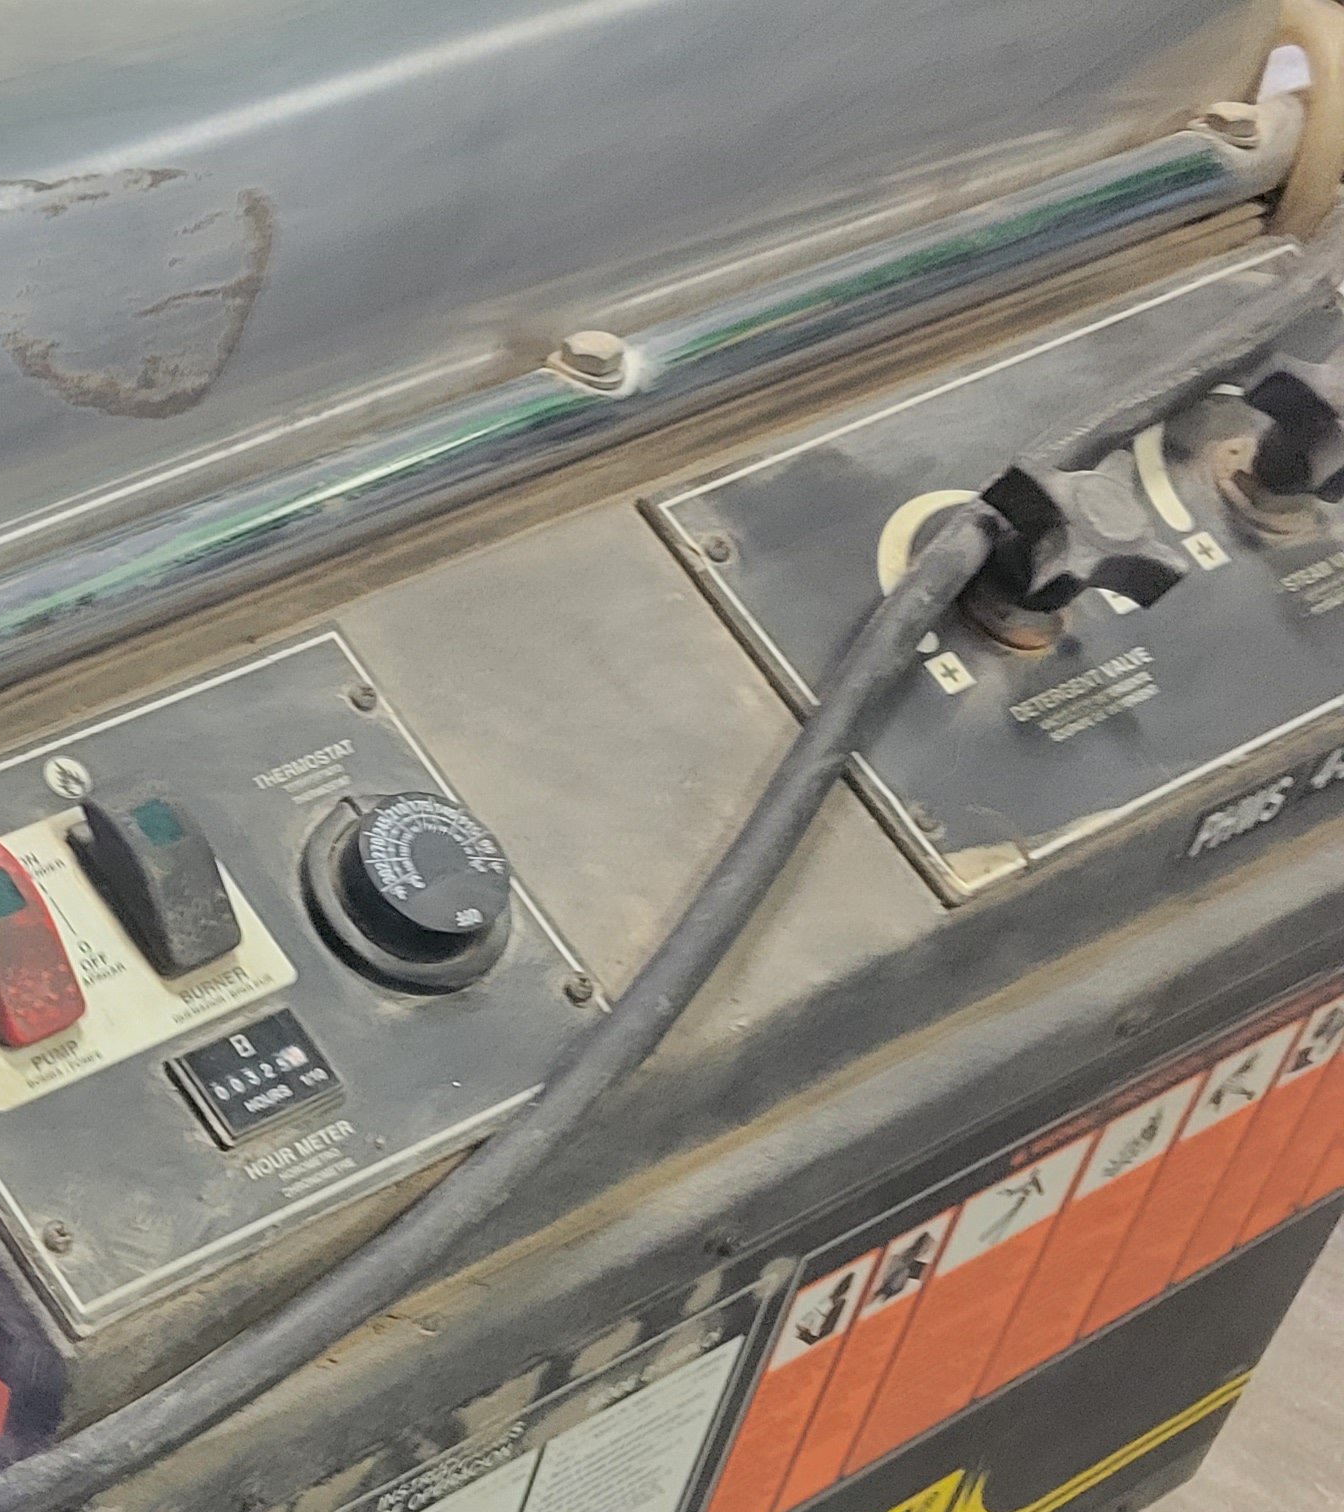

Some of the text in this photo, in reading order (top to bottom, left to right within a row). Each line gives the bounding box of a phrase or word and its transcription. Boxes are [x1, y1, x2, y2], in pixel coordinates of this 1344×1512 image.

[1099, 646, 1155, 677] VALVE
[253, 739, 356, 790] THERMOSTAT
[80, 953, 108, 972] OFF
[179, 966, 250, 1003] BURNER
[31, 1039, 80, 1073] PUMP
[243, 1084, 294, 1113] HOURS
[244, 1120, 356, 1180] HOUR METER
